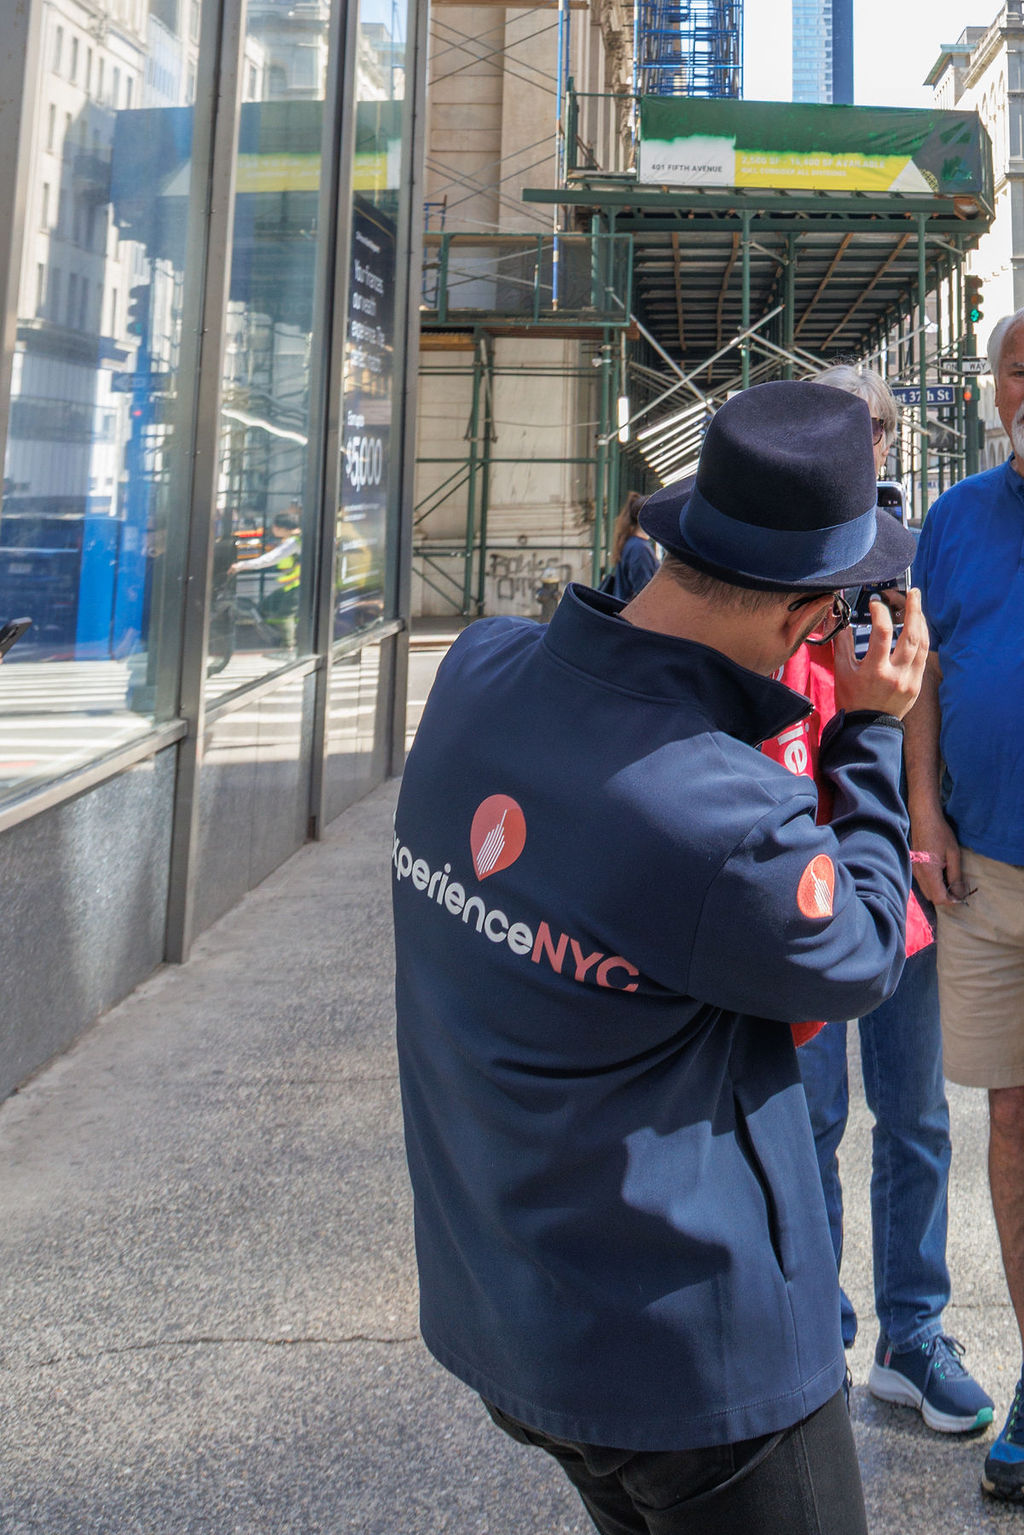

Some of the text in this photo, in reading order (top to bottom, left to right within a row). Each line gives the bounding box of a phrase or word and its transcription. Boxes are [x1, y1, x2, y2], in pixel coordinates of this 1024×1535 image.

[667, 164, 690, 172] FIFTH
[692, 165, 723, 173] AVENUE
[836, 159, 885, 169] AVAILABLE
[969, 363, 986, 371] WAY
[909, 390, 935, 403] 37h
[937, 389, 950, 401] St
[345, 436, 383, 493] $5,000
[392, 830, 640, 993] xperienceNYC
